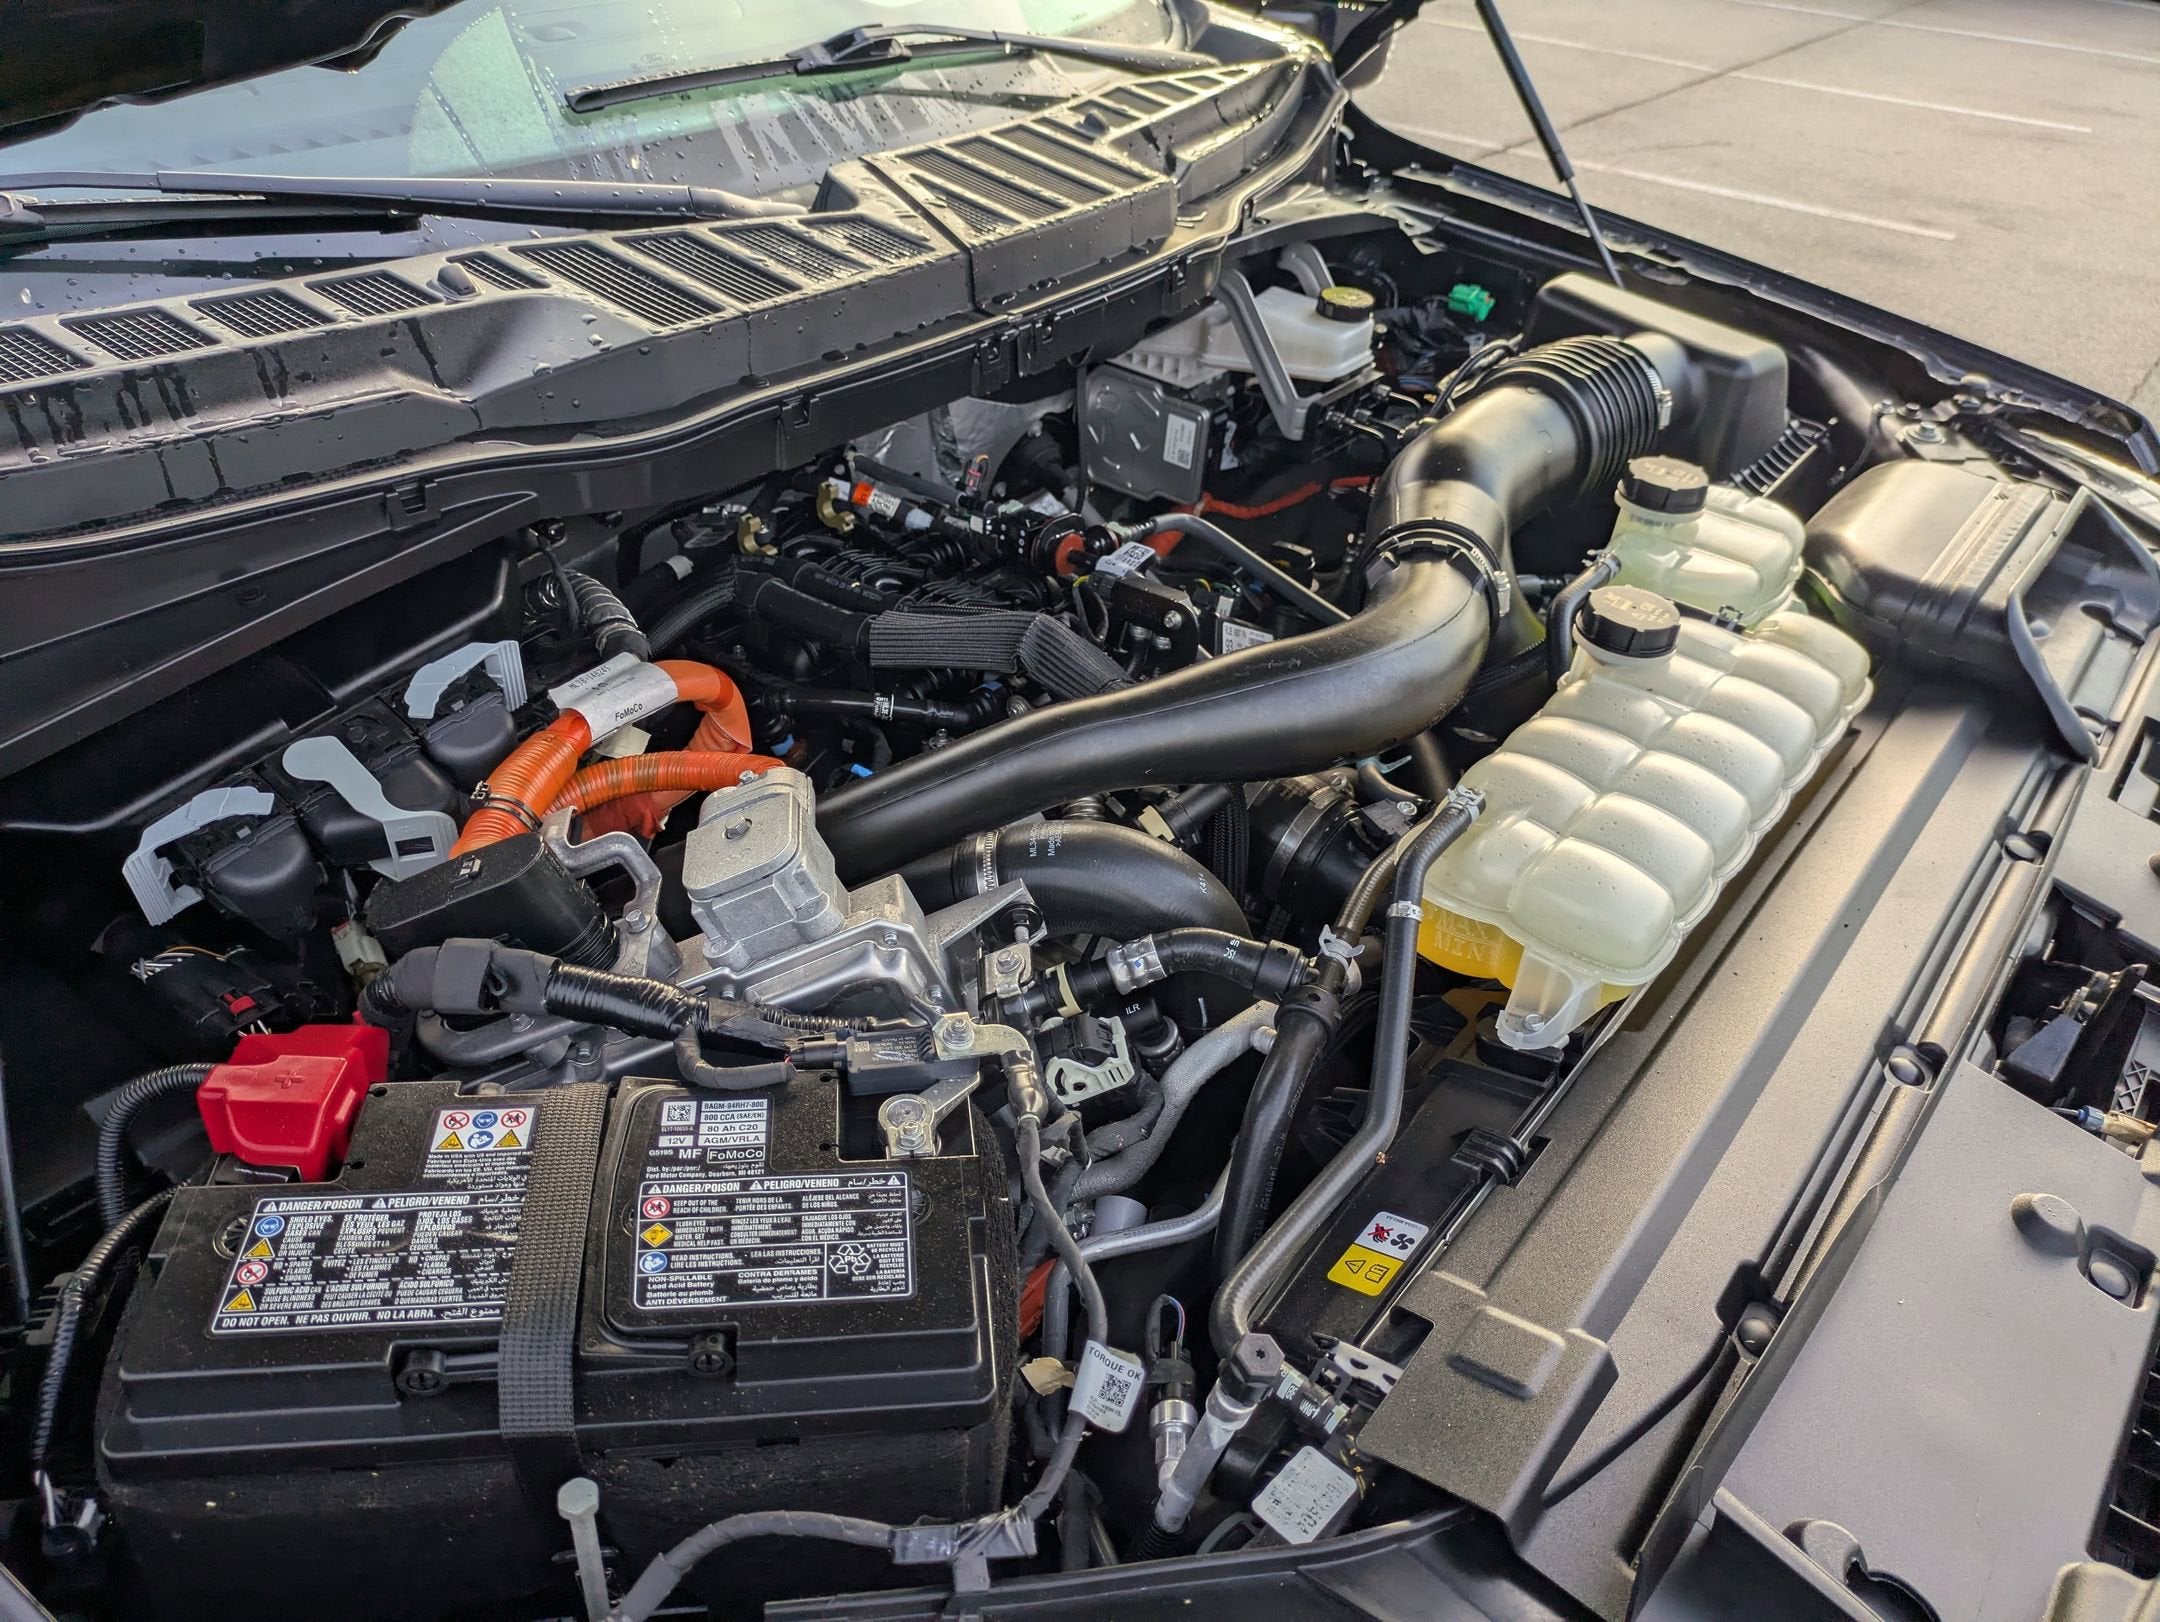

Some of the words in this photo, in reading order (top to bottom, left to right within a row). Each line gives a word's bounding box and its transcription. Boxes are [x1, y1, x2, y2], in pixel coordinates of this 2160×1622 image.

[615, 703, 643, 721] FoMoCo
[1230, 939, 1240, 948] UP
[1434, 930, 1483, 961] MIN
[1223, 947, 1236, 960] ISC
[1125, 1003, 1140, 1015] ILR
[720, 1113, 735, 1121] CCA
[722, 1124, 735, 1132] Ah
[738, 1123, 758, 1131] C20
[667, 1137, 686, 1145] 12V
[704, 1135, 760, 1144] AGM/VRLA
[679, 1148, 702, 1159] MF
[709, 1150, 763, 1160] FoMoCo
[662, 1182, 740, 1194] DANGER/POISON
[764, 1178, 839, 1190] PELIGRO/VENENO
[278, 1199, 363, 1212] DANGER/POISON
[388, 1195, 470, 1208] PELIGRO/VENENO
[290, 1216, 313, 1224] SHIELD
[314, 1215, 333, 1223] EYES.
[287, 1222, 325, 1230] EXPLOSIVE
[689, 1253, 735, 1261] INSTRUCTIONS.
[775, 1248, 823, 1257] INSTRUCCIONES.
[322, 1259, 346, 1268] ÉVITEZ
[408, 1256, 418, 1264] NO
[698, 1259, 744, 1268] INSTRUCTIONS.
[273, 1261, 283, 1269] NO
[773, 1269, 818, 1277] DERRAMES
[648, 1275, 713, 1283] NON-SPILLABLE
[351, 1282, 390, 1291] SULFURIQUE
[648, 1282, 666, 1290] Lead
[264, 1287, 294, 1295] SULFURIC
[415, 1288, 438, 1296] CAUSAR
[283, 1294, 316, 1302] BLINDNESS
[400, 1296, 437, 1304] QUEMADURAS
[222, 1318, 236, 1327] DO
[238, 1317, 258, 1327] NOT
[261, 1315, 290, 1326] OPEN.
[295, 1315, 308, 1324] NE
[311, 1313, 330, 1323] PAS
[331, 1312, 371, 1322] OUVRIR.
[376, 1311, 390, 1320] NO
[393, 1310, 407, 1319] LA
[407, 1309, 436, 1319] ABRA.
[1088, 1346, 1126, 1374] TORQUE
[1127, 1369, 1142, 1380] OK
